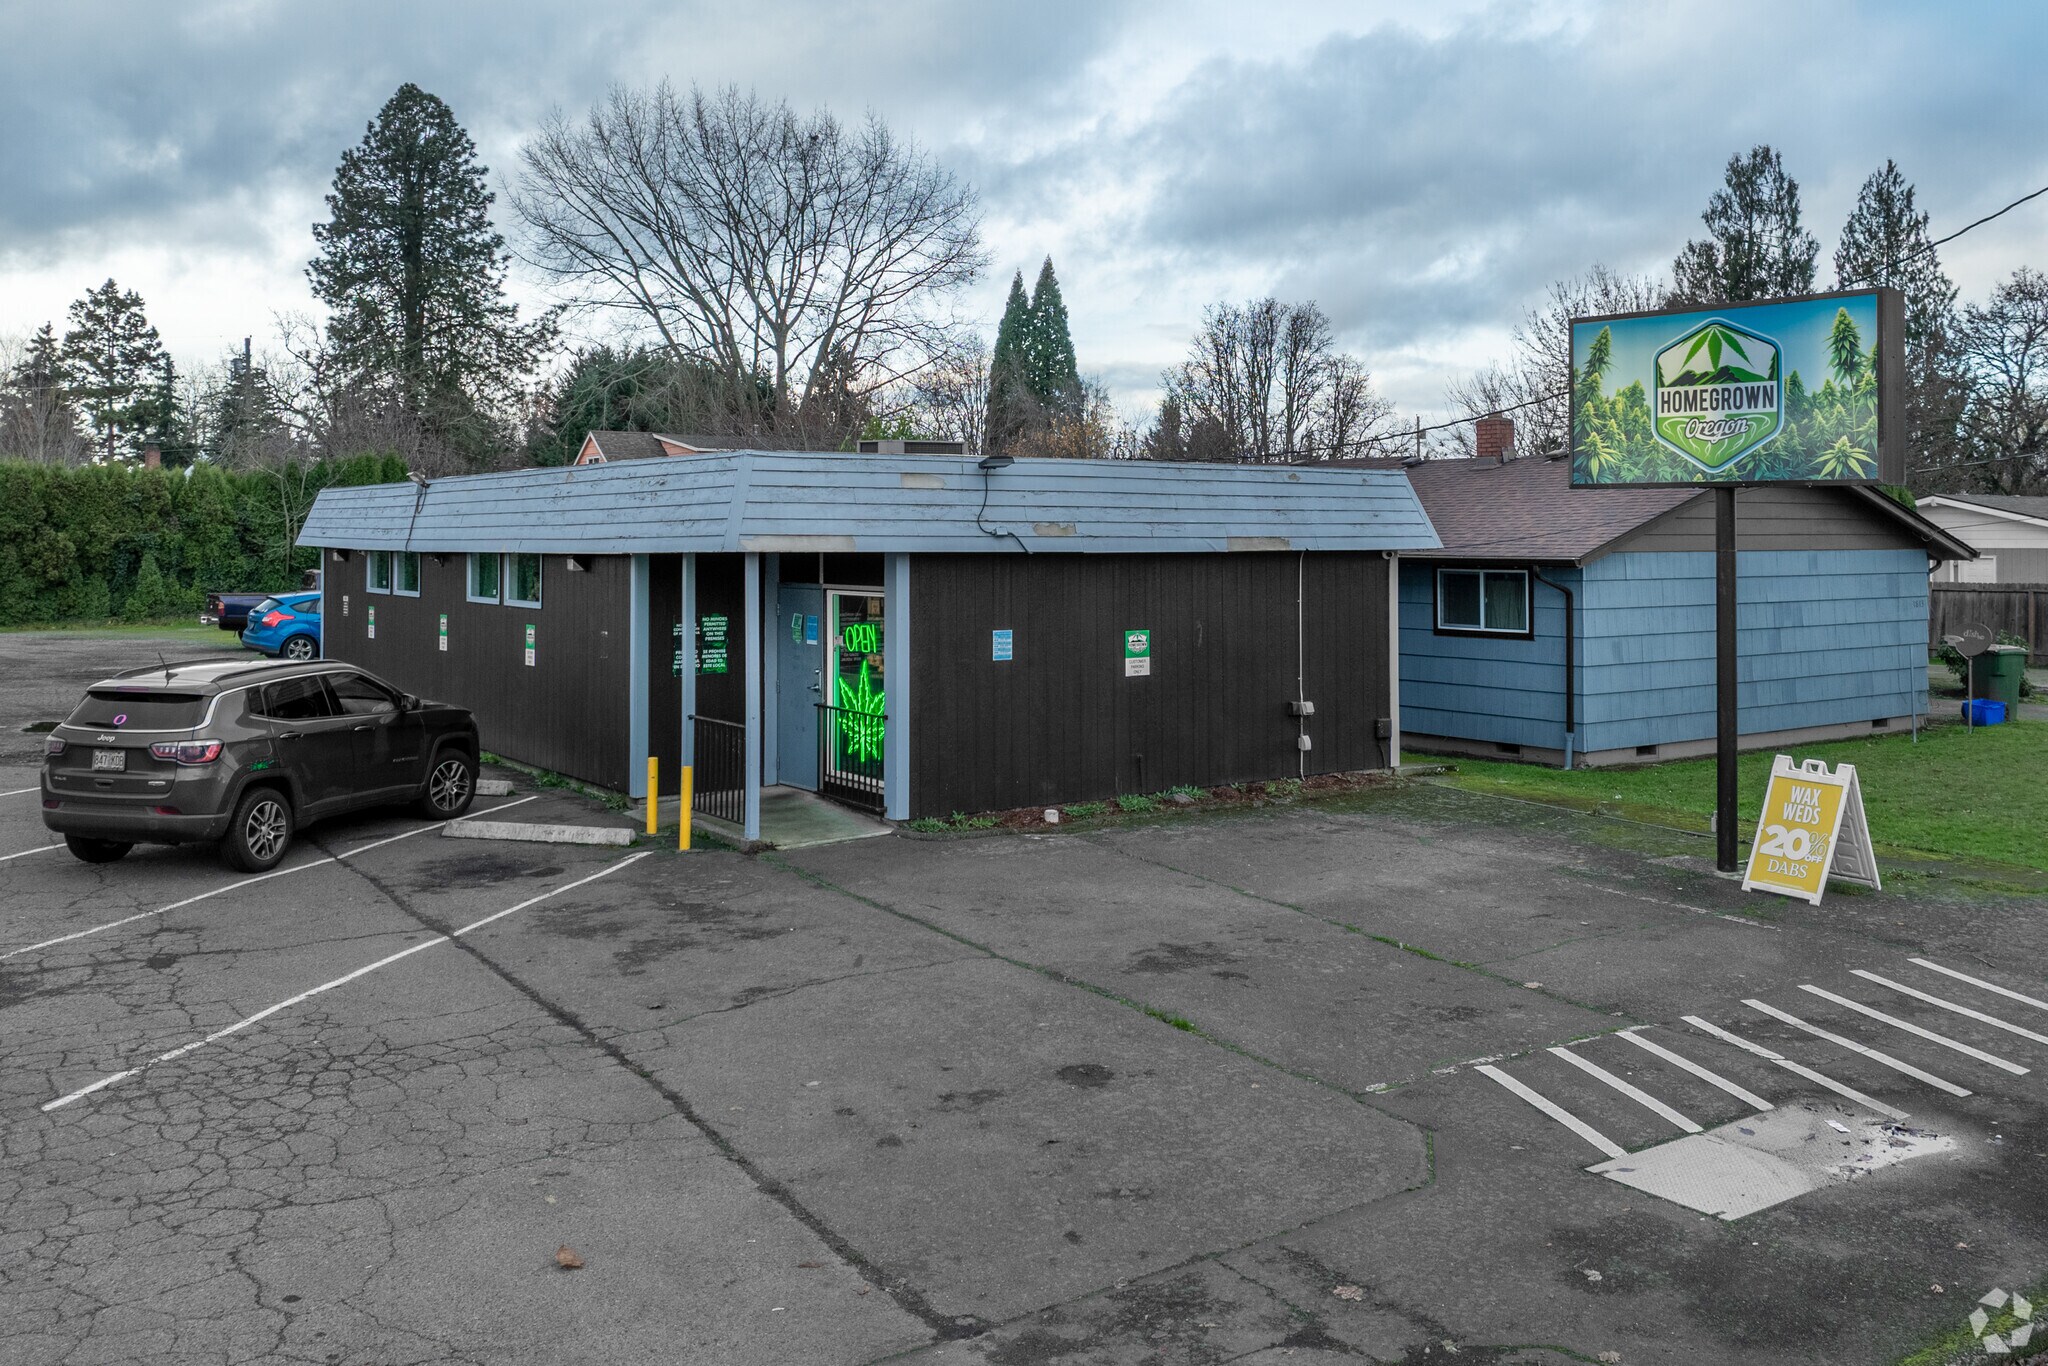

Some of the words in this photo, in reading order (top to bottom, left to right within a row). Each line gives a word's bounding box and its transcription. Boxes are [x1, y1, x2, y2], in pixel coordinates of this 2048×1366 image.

[1660, 385, 1774, 413] HOMEGROWN
[1685, 418, 1749, 444] Oregon
[845, 624, 877, 653] OPEN
[97, 734, 116, 743] Jeep
[1790, 785, 1822, 807] WAX
[1782, 802, 1822, 825] WEDS
[1759, 824, 1828, 861] 20%
[1766, 858, 1809, 879] DABS
[1804, 854, 1824, 864] OFF
